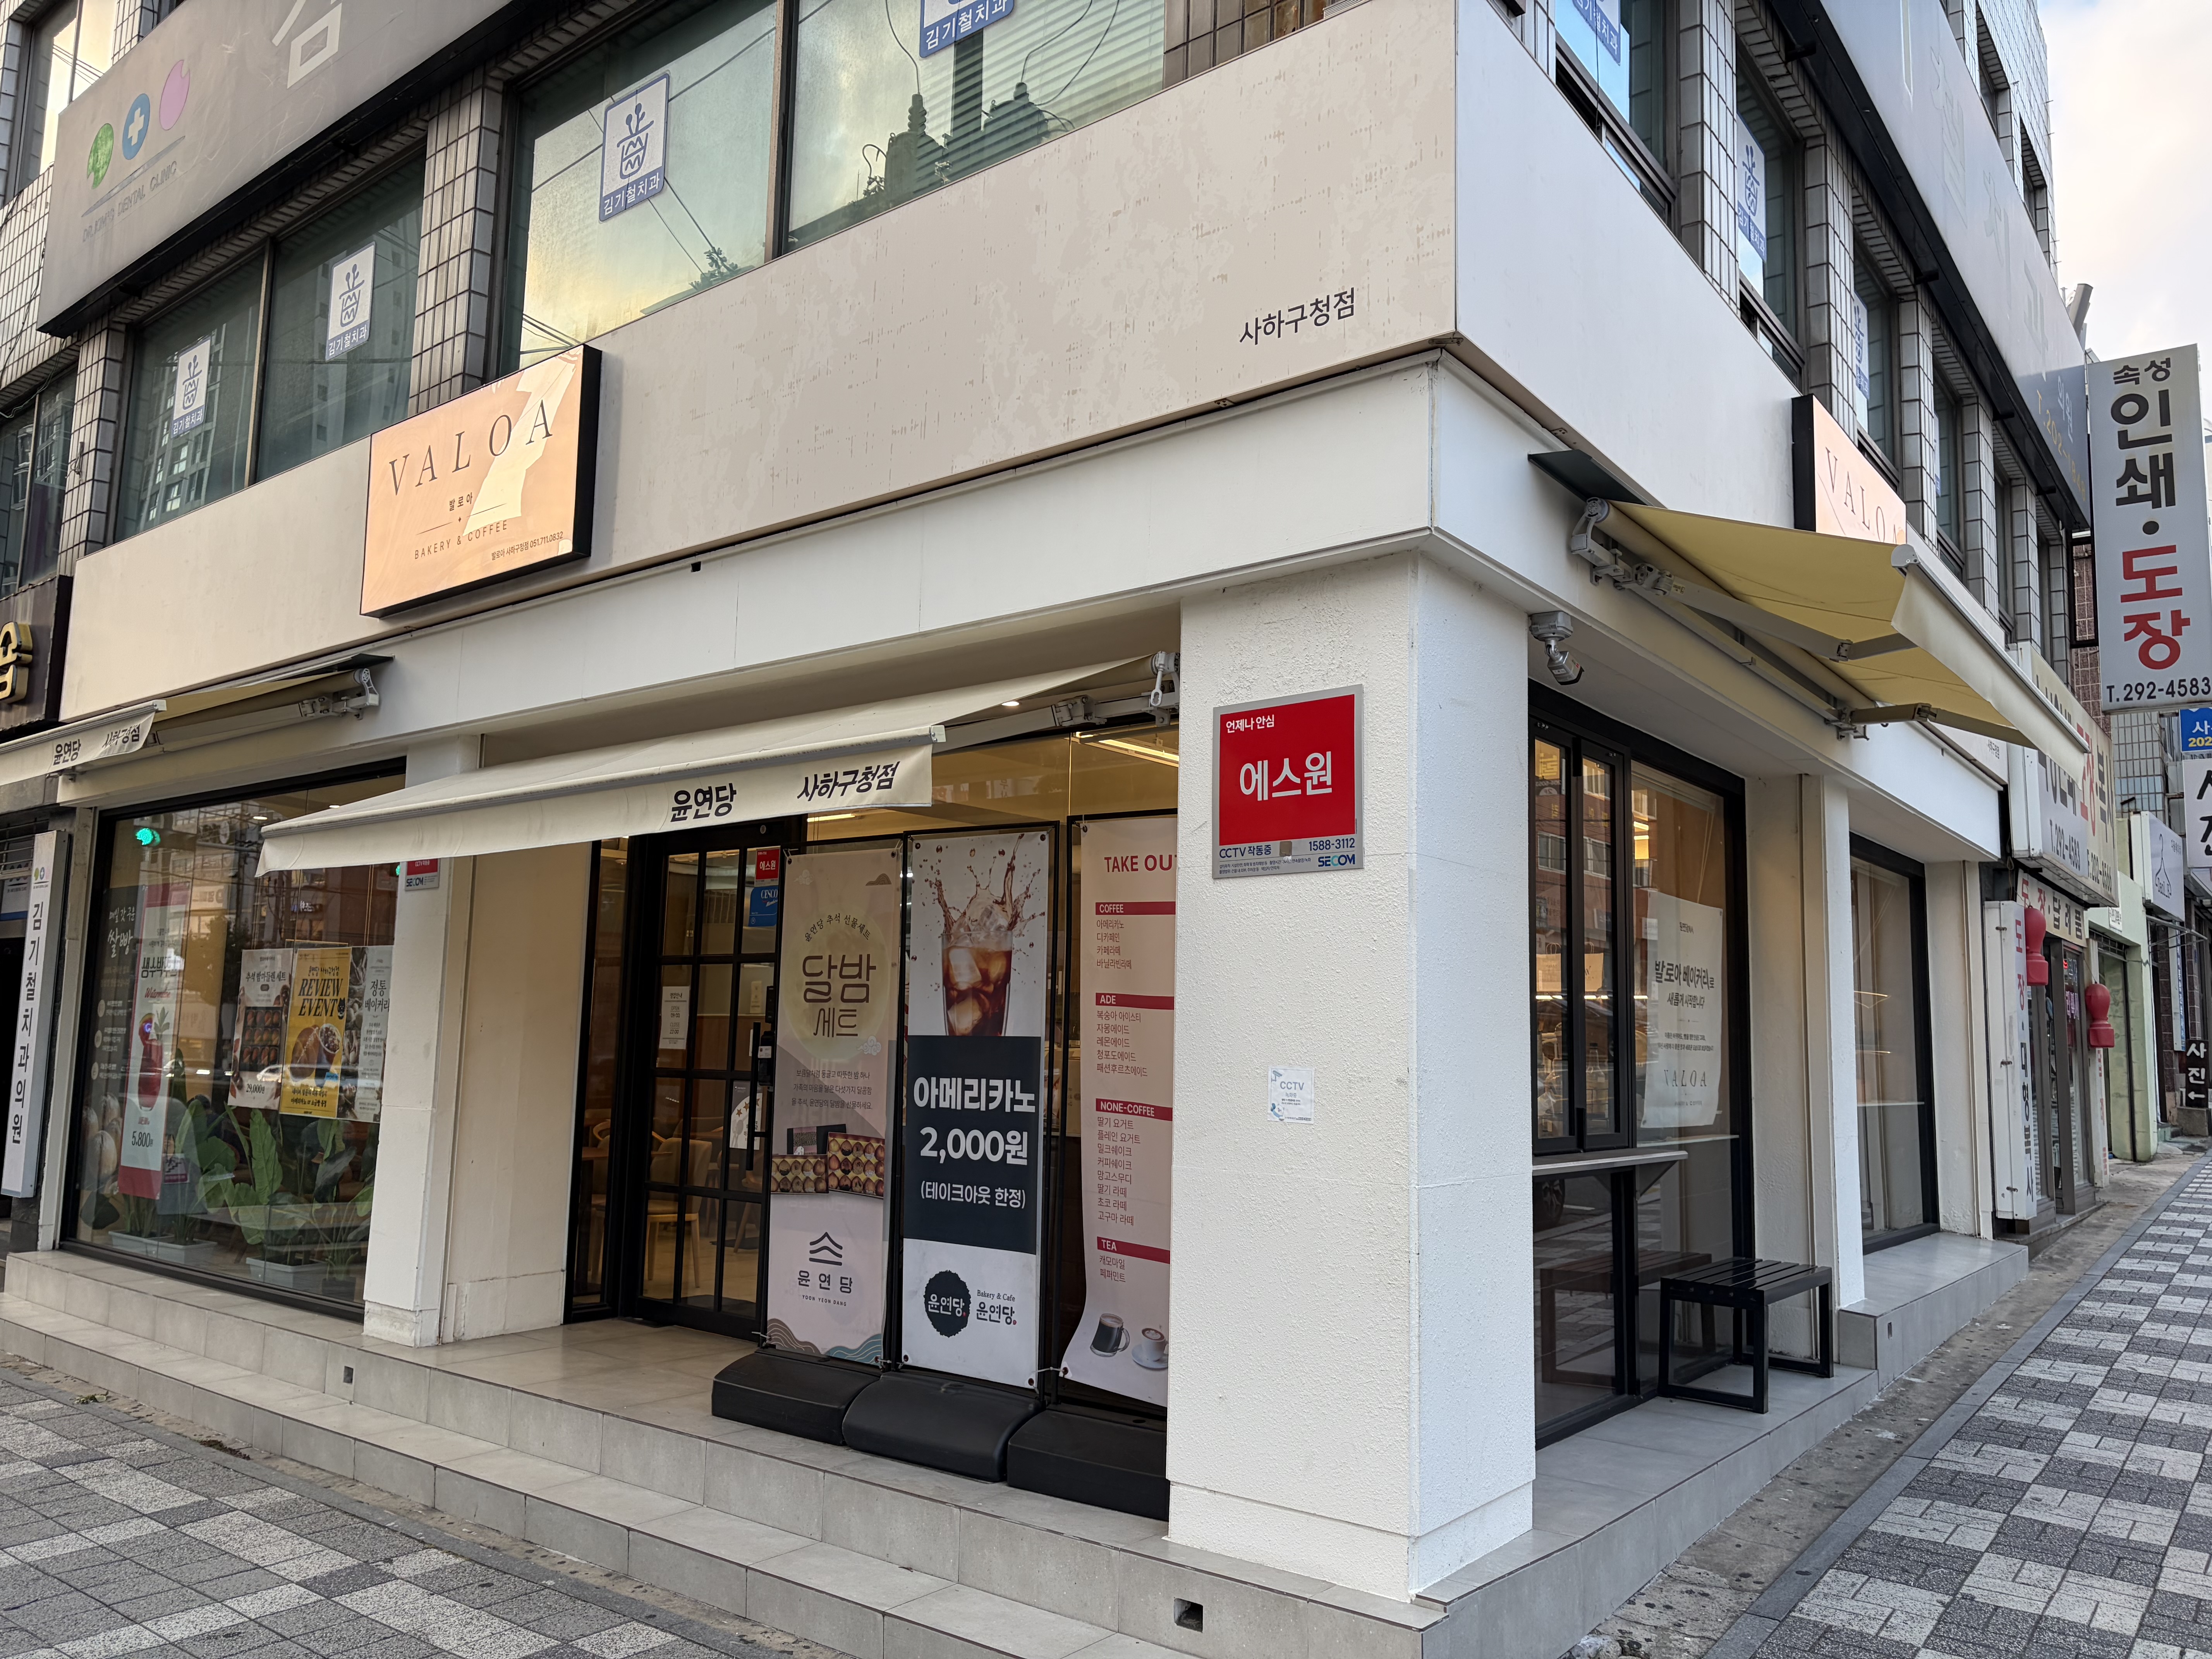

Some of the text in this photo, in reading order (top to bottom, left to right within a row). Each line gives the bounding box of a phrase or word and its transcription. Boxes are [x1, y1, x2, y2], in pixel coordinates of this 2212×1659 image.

[926, 0, 1007, 50] 김기철치과
[117, 190, 146, 217] DENTAL
[150, 160, 177, 192] CLINIC
[604, 172, 659, 215] 김기철치과
[1240, 287, 1354, 345] 사하구청점
[328, 324, 367, 357] 김기철치과
[2113, 357, 2172, 385] 속성
[173, 409, 203, 434] 김기철치과
[389, 399, 552, 495] VALOA
[449, 493, 473, 512] 발로아
[415, 520, 507, 560] BAKERY & COFFEE
[491, 531, 563, 560] 발로아 사하구청점 051.711.0832
[2107, 677, 2210, 702] T.292-4583
[1226, 714, 1275, 733] 언제나 안심
[53, 739, 81, 766] 윤연당
[1240, 751, 1332, 801] 에스원
[671, 761, 900, 823] 윤연당 사하구청점
[1219, 838, 1355, 858] CCTV 작동중 1588-3112
[2050, 819, 2080, 871] T.292-4583
[760, 860, 776, 871] 에스원
[1104, 854, 1177, 872] TAKE OU
[1318, 854, 1355, 867] SECOM
[406, 877, 423, 887] SECOM
[761, 889, 778, 899] CESCO
[1099, 904, 1124, 913] COFFEE
[805, 913, 871, 942] 윤연당 추석 선물세트
[1097, 919, 1125, 929] 아메리카노
[1097, 933, 1120, 942] 디카페인
[1097, 946, 1121, 956] 카페라떼
[1097, 959, 1132, 969] 바닐라빈라떼
[246, 971, 255, 982] 추석
[276, 971, 286, 981] 세트
[802, 953, 876, 1003] 달밤
[1655, 960, 1681, 987] 발로아
[298, 978, 343, 996] REVIEW
[370, 979, 386, 996] 정통
[298, 998, 338, 1017] EVENT
[365, 998, 390, 1013] 베이커리
[1100, 995, 1116, 1004] ADE
[11, 902, 43, 1145] 김기철치과의원
[813, 1008, 858, 1037] 세트
[1097, 1010, 1141, 1023] 복숭아 아이스티
[1097, 1024, 1130, 1034] 자몽에이드
[1097, 1037, 1130, 1048] 레몬에이드
[1097, 1049, 1136, 1061] 청포도에이드
[2186, 1042, 2207, 1084] 사진
[796, 1069, 820, 1078] 보름달처럼
[821, 1070, 836, 1079] 둥글고
[837, 1071, 852, 1079] 따뜻한
[860, 1072, 870, 1080] 하나
[1097, 1063, 1147, 1077] 패션후르츠에이드
[1664, 1069, 1707, 1087] VALOA
[793, 1084, 808, 1092] 가족의
[809, 1084, 823, 1092] 마음을
[835, 1085, 856, 1094] 다섯가지
[857, 1086, 872, 1095] 달콤함
[1280, 1081, 1304, 1091] CCTV
[914, 1077, 1036, 1112] 아메리카노
[809, 1099, 829, 1108] 윤연당의
[830, 1100, 845, 1108] 달밤을
[1100, 1101, 1155, 1117] NONE-COFFEE
[1097, 1116, 1134, 1130] 딸기 요거트
[1097, 1130, 1140, 1144] 플레인 요거트
[920, 1127, 1028, 1165] 2,000원
[1097, 1143, 1132, 1156] 밀크쉐이크
[1097, 1157, 1132, 1170] 커피쉐이크
[1097, 1170, 1132, 1185] 망고스무디
[921, 1180, 1025, 1209] (테이크아웃 한정)
[1097, 1183, 1127, 1198] 딸기 라떼
[1097, 1197, 1127, 1211] 초코 라떼
[1097, 1211, 1134, 1226] 고구마 라떼
[1101, 1239, 1117, 1252] TEA
[1099, 1255, 1125, 1270] 캐모마일
[1100, 1269, 1126, 1283] 페퍼민트
[977, 1290, 995, 1300] Bakery
[976, 1302, 1015, 1325] 윤연당
